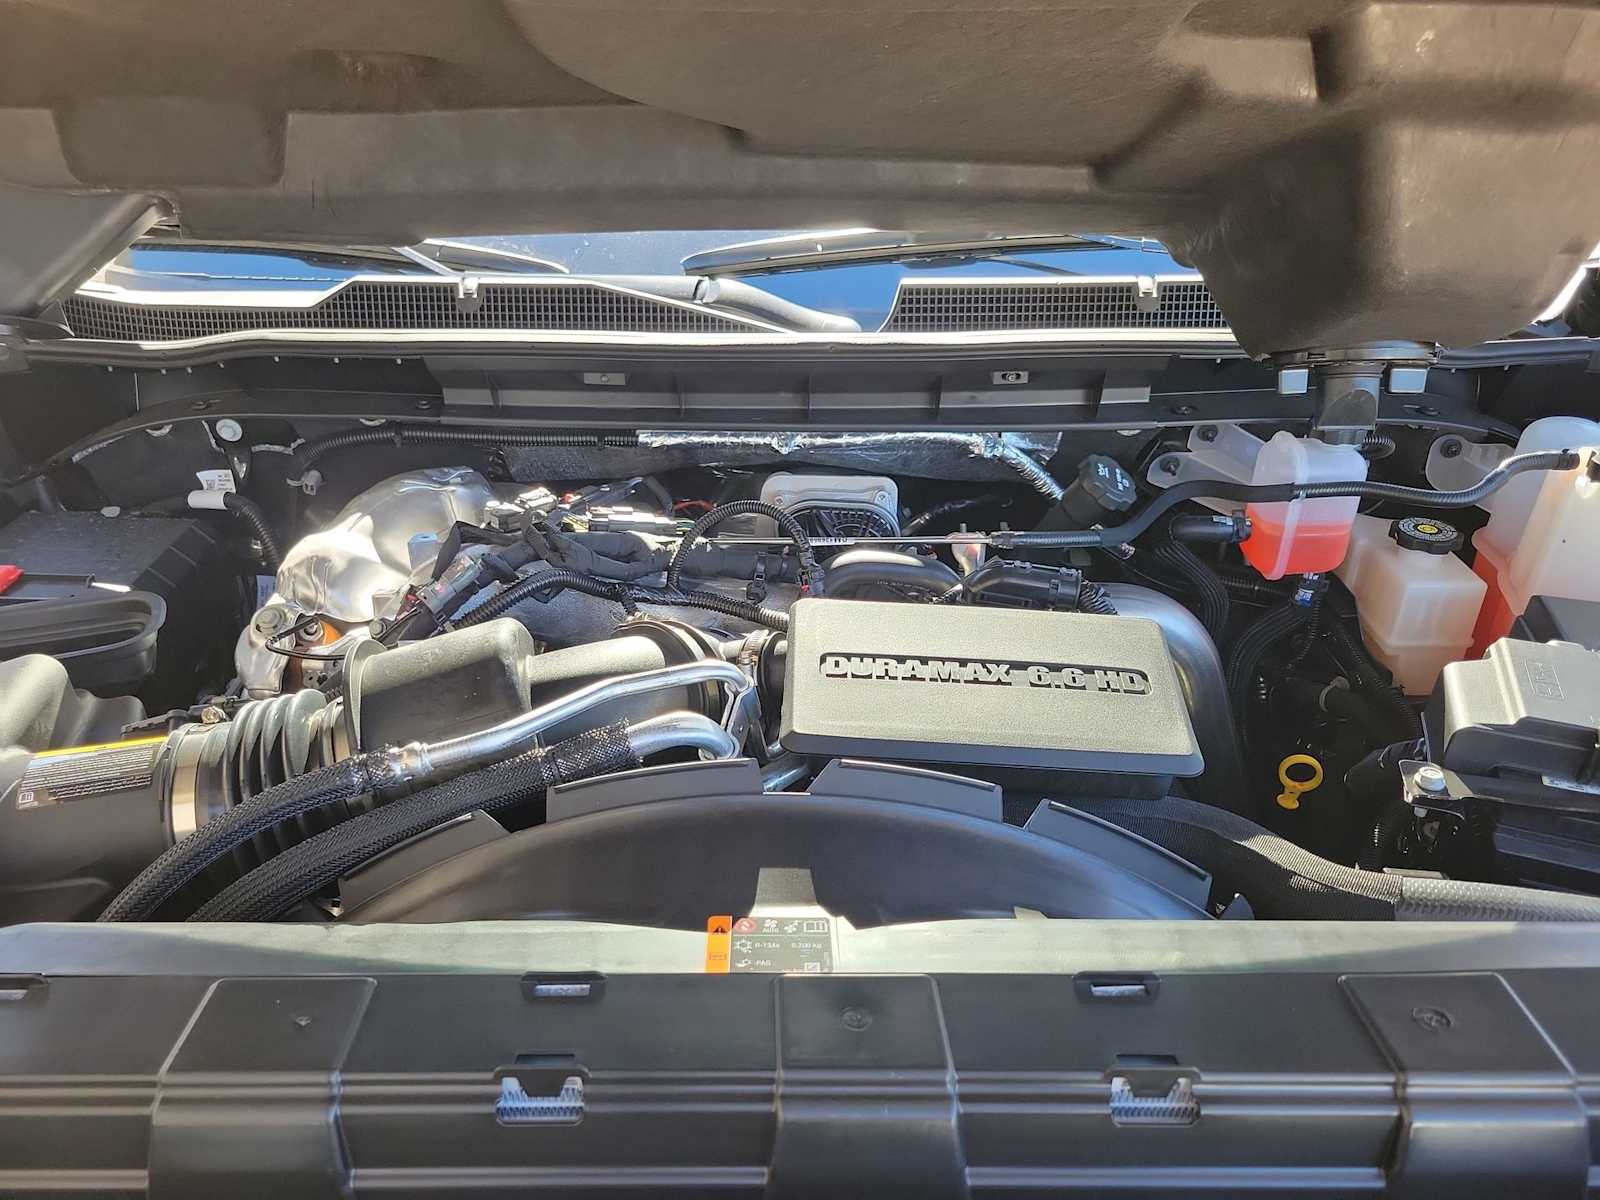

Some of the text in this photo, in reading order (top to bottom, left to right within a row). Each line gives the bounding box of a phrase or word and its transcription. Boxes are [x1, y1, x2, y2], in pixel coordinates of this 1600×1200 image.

[823, 655, 1151, 694] DURAMAX 6.6 HD
